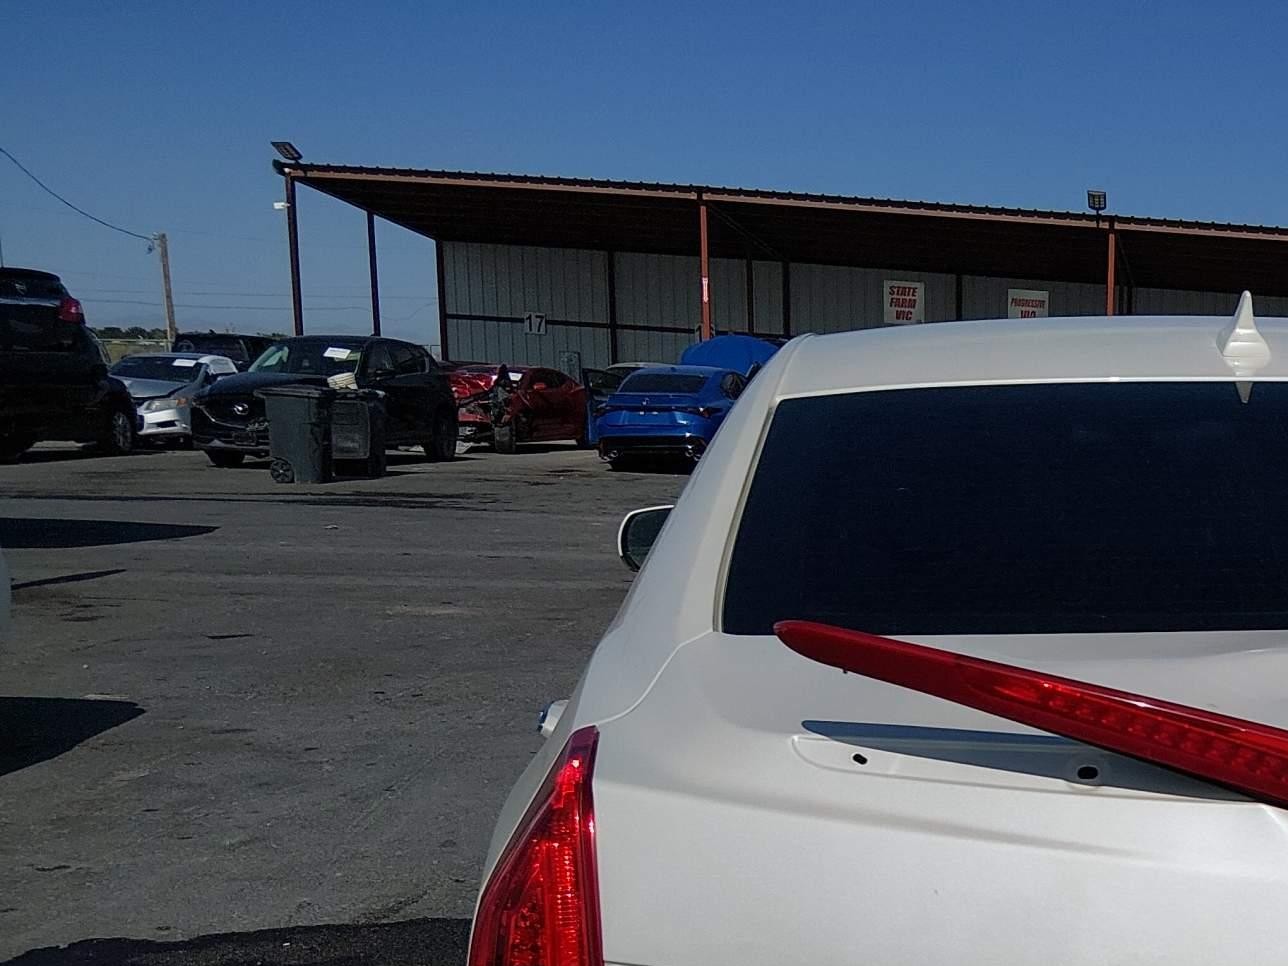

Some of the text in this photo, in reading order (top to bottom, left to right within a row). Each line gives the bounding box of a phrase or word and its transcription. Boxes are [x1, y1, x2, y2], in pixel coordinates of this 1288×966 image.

[889, 286, 918, 298] STATE
[889, 297, 917, 309] FARM
[895, 310, 913, 321] VIC
[526, 313, 545, 333] 17
